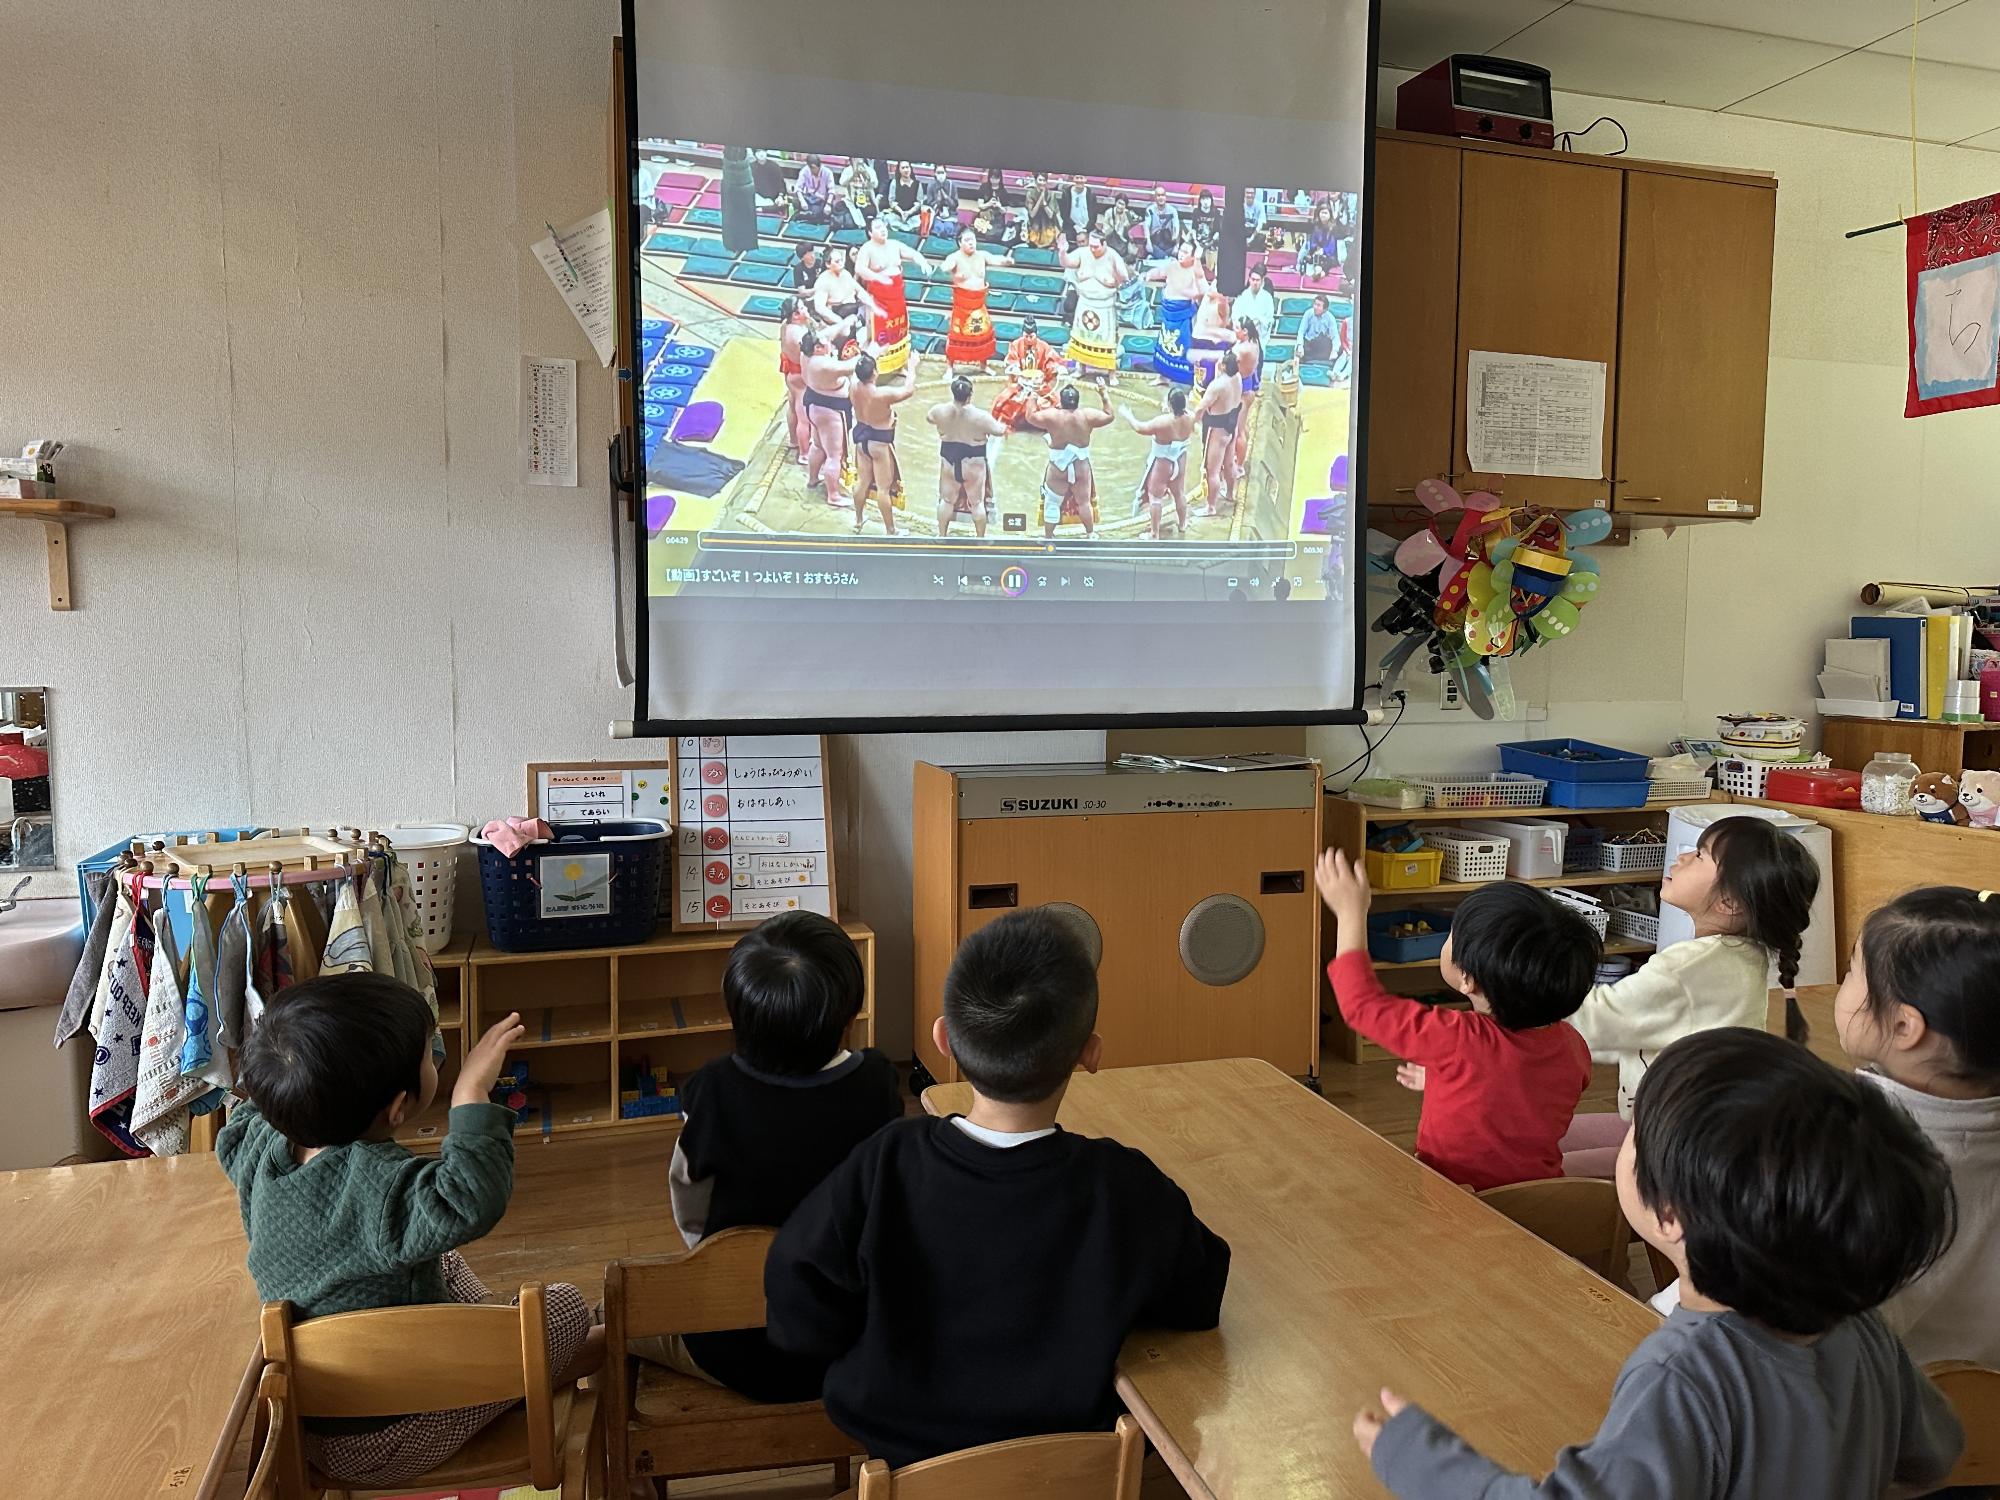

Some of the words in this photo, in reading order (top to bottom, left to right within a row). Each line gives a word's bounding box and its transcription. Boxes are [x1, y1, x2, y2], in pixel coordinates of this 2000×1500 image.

[708, 768, 723, 778] か
[583, 790, 606, 798] といれ
[737, 796, 796, 808] おはなしあい
[1018, 798, 1078, 811] SUZUKI
[580, 808, 610, 816] てあらい
[684, 832, 697, 844] 13
[707, 834, 725, 844] もく
[708, 867, 726, 880] きん
[756, 876, 791, 886] そとあそび
[686, 900, 700, 914] 15
[711, 901, 724, 913] と
[744, 900, 780, 909] そとあそび
